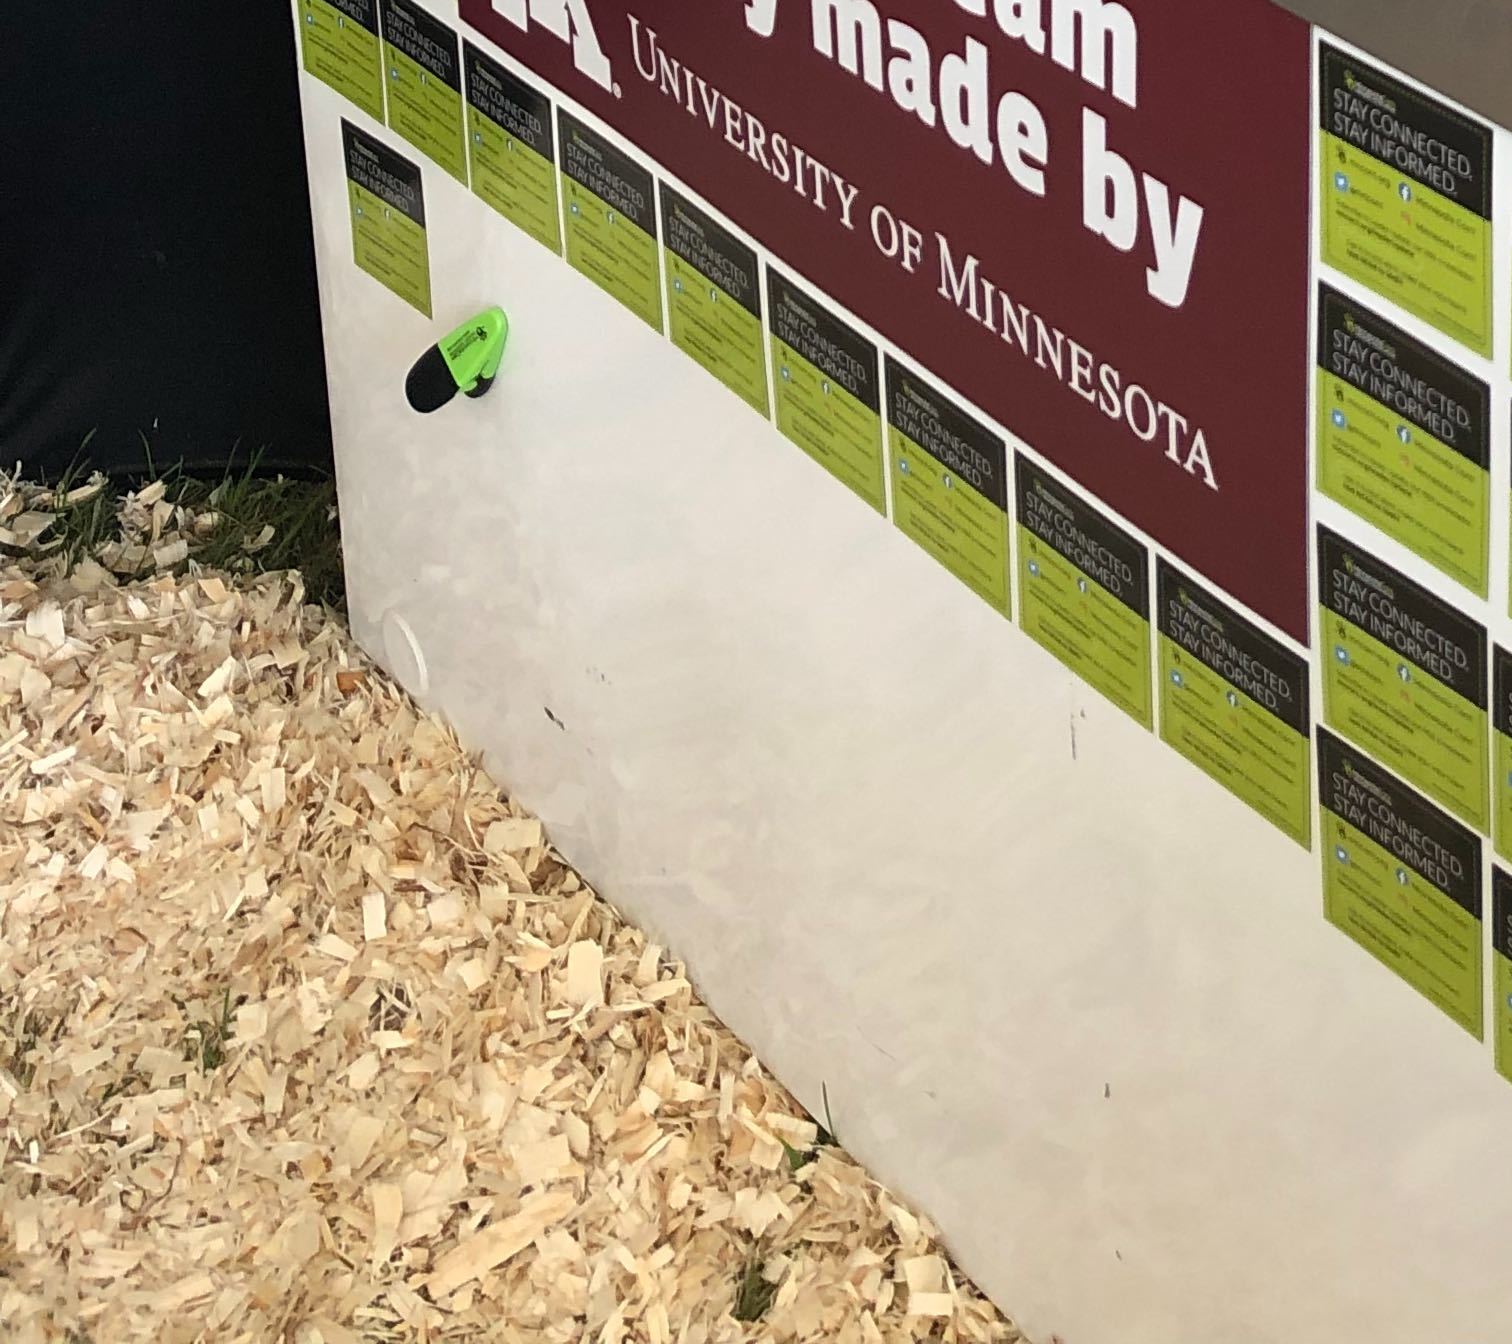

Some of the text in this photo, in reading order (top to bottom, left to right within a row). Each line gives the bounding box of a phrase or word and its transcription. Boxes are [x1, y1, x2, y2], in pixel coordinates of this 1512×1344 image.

[566, 139, 645, 212] STAY CONNECTED.
[1333, 85, 1368, 123] STAY
[1370, 104, 1473, 183] CONNECTED.
[1333, 109, 1369, 148] STAY
[1370, 129, 1457, 199] INFORMED.
[567, 156, 638, 223] STAY INFORMED.
[1082, 106, 1204, 308] by
[628, 13, 859, 230] UNIVERSITY
[870, 205, 923, 273] OF
[934, 231, 1219, 491] MINNESOTA
[668, 213, 749, 291] STAY CONNECTED.
[670, 231, 742, 302] STAY INFORMED.
[776, 301, 867, 385] STAY CONNECTED.
[778, 318, 858, 396] STAY INFORMED.
[1332, 325, 1368, 365] STAY
[1369, 348, 1471, 433] CONNECTED.
[895, 389, 993, 481] STAY CONNECTED.
[1332, 348, 1456, 446] STAY INFORMED.
[896, 408, 983, 492] STAY INFORMED.
[1026, 489, 1134, 588] STAY CONNECTED.
[1027, 508, 1123, 599] STAY INFORMED.
[1169, 598, 1199, 634] STAY
[1201, 620, 1292, 704] CONNECTED.
[1169, 617, 1279, 715] STAY INFORMED.
[1332, 565, 1366, 604] STAY
[1368, 588, 1469, 674] CONNECTED.
[1333, 587, 1455, 686] STAY INFORMED.
[1331, 767, 1365, 808] STAY
[1367, 792, 1464, 883] CONNECTED.
[1333, 788, 1451, 894] STAY INFORMED.
